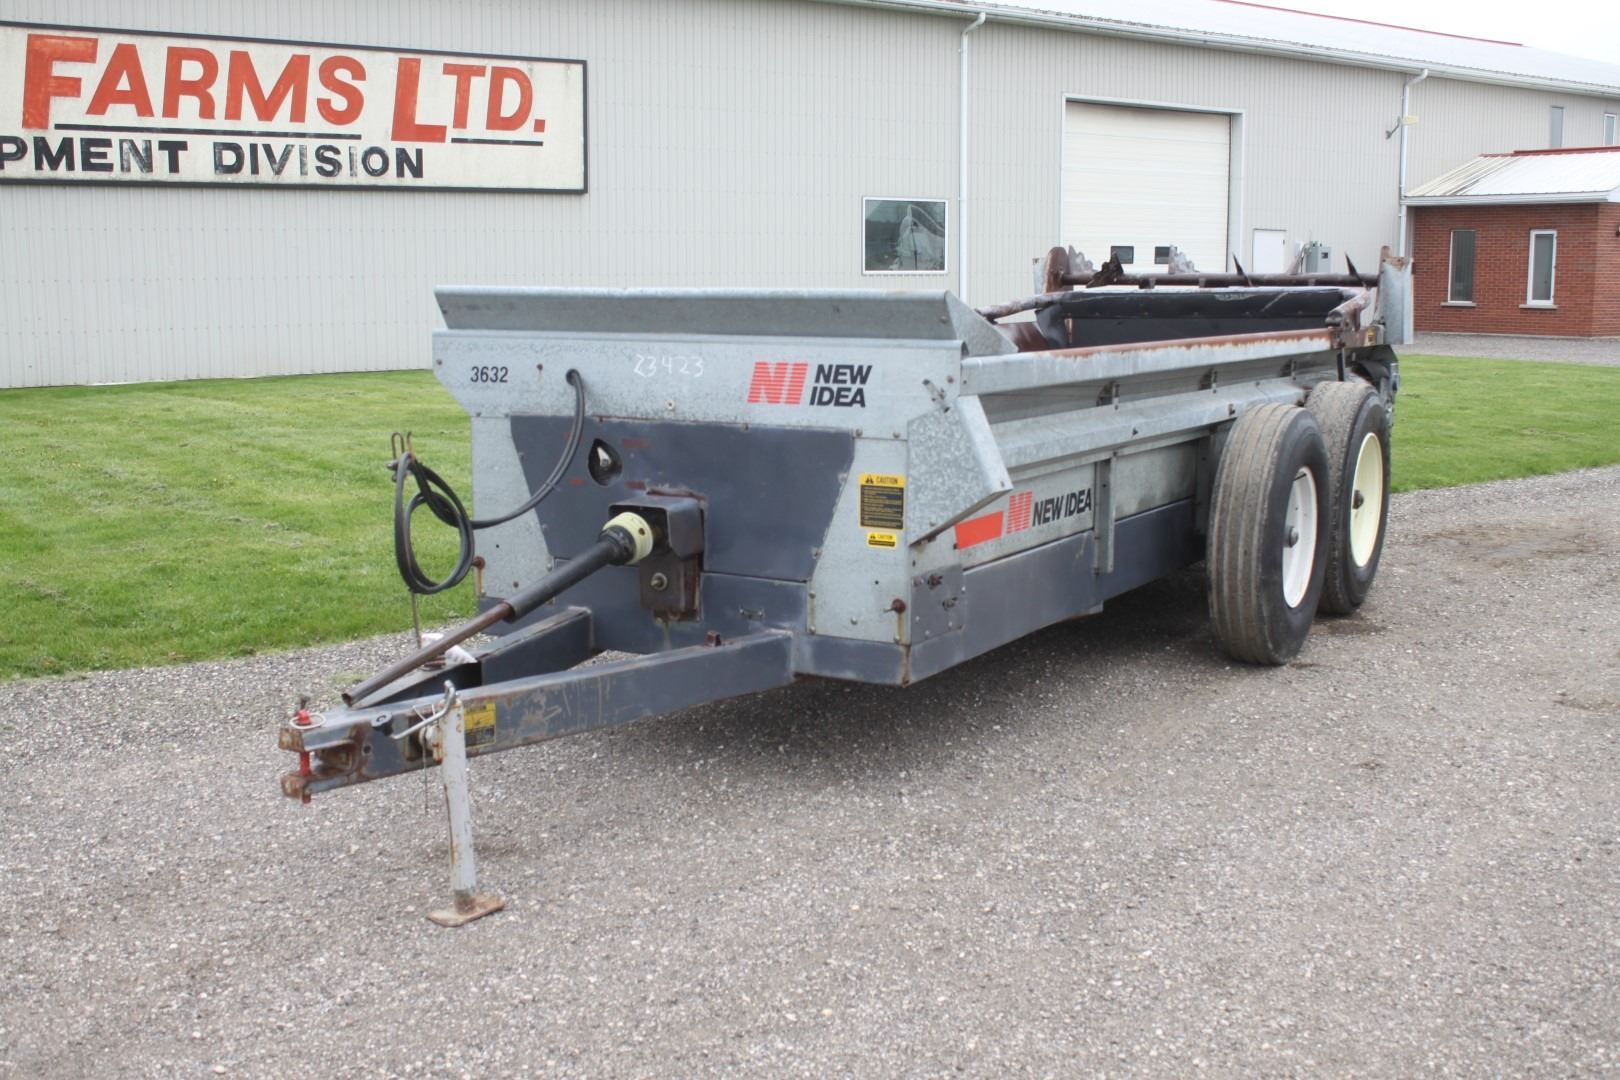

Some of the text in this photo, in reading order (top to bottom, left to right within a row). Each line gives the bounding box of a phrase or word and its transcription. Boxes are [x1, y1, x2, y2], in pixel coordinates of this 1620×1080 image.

[22, 33, 545, 143] FARMS LTD.
[0, 135, 424, 179] PMENT DIVISION
[470, 366, 508, 383] 3632
[633, 353, 703, 378] 23423
[814, 364, 872, 385] NEW
[809, 386, 865, 408] IDEA
[1032, 495, 1064, 527] NEW
[1064, 488, 1091, 518] IDEA
